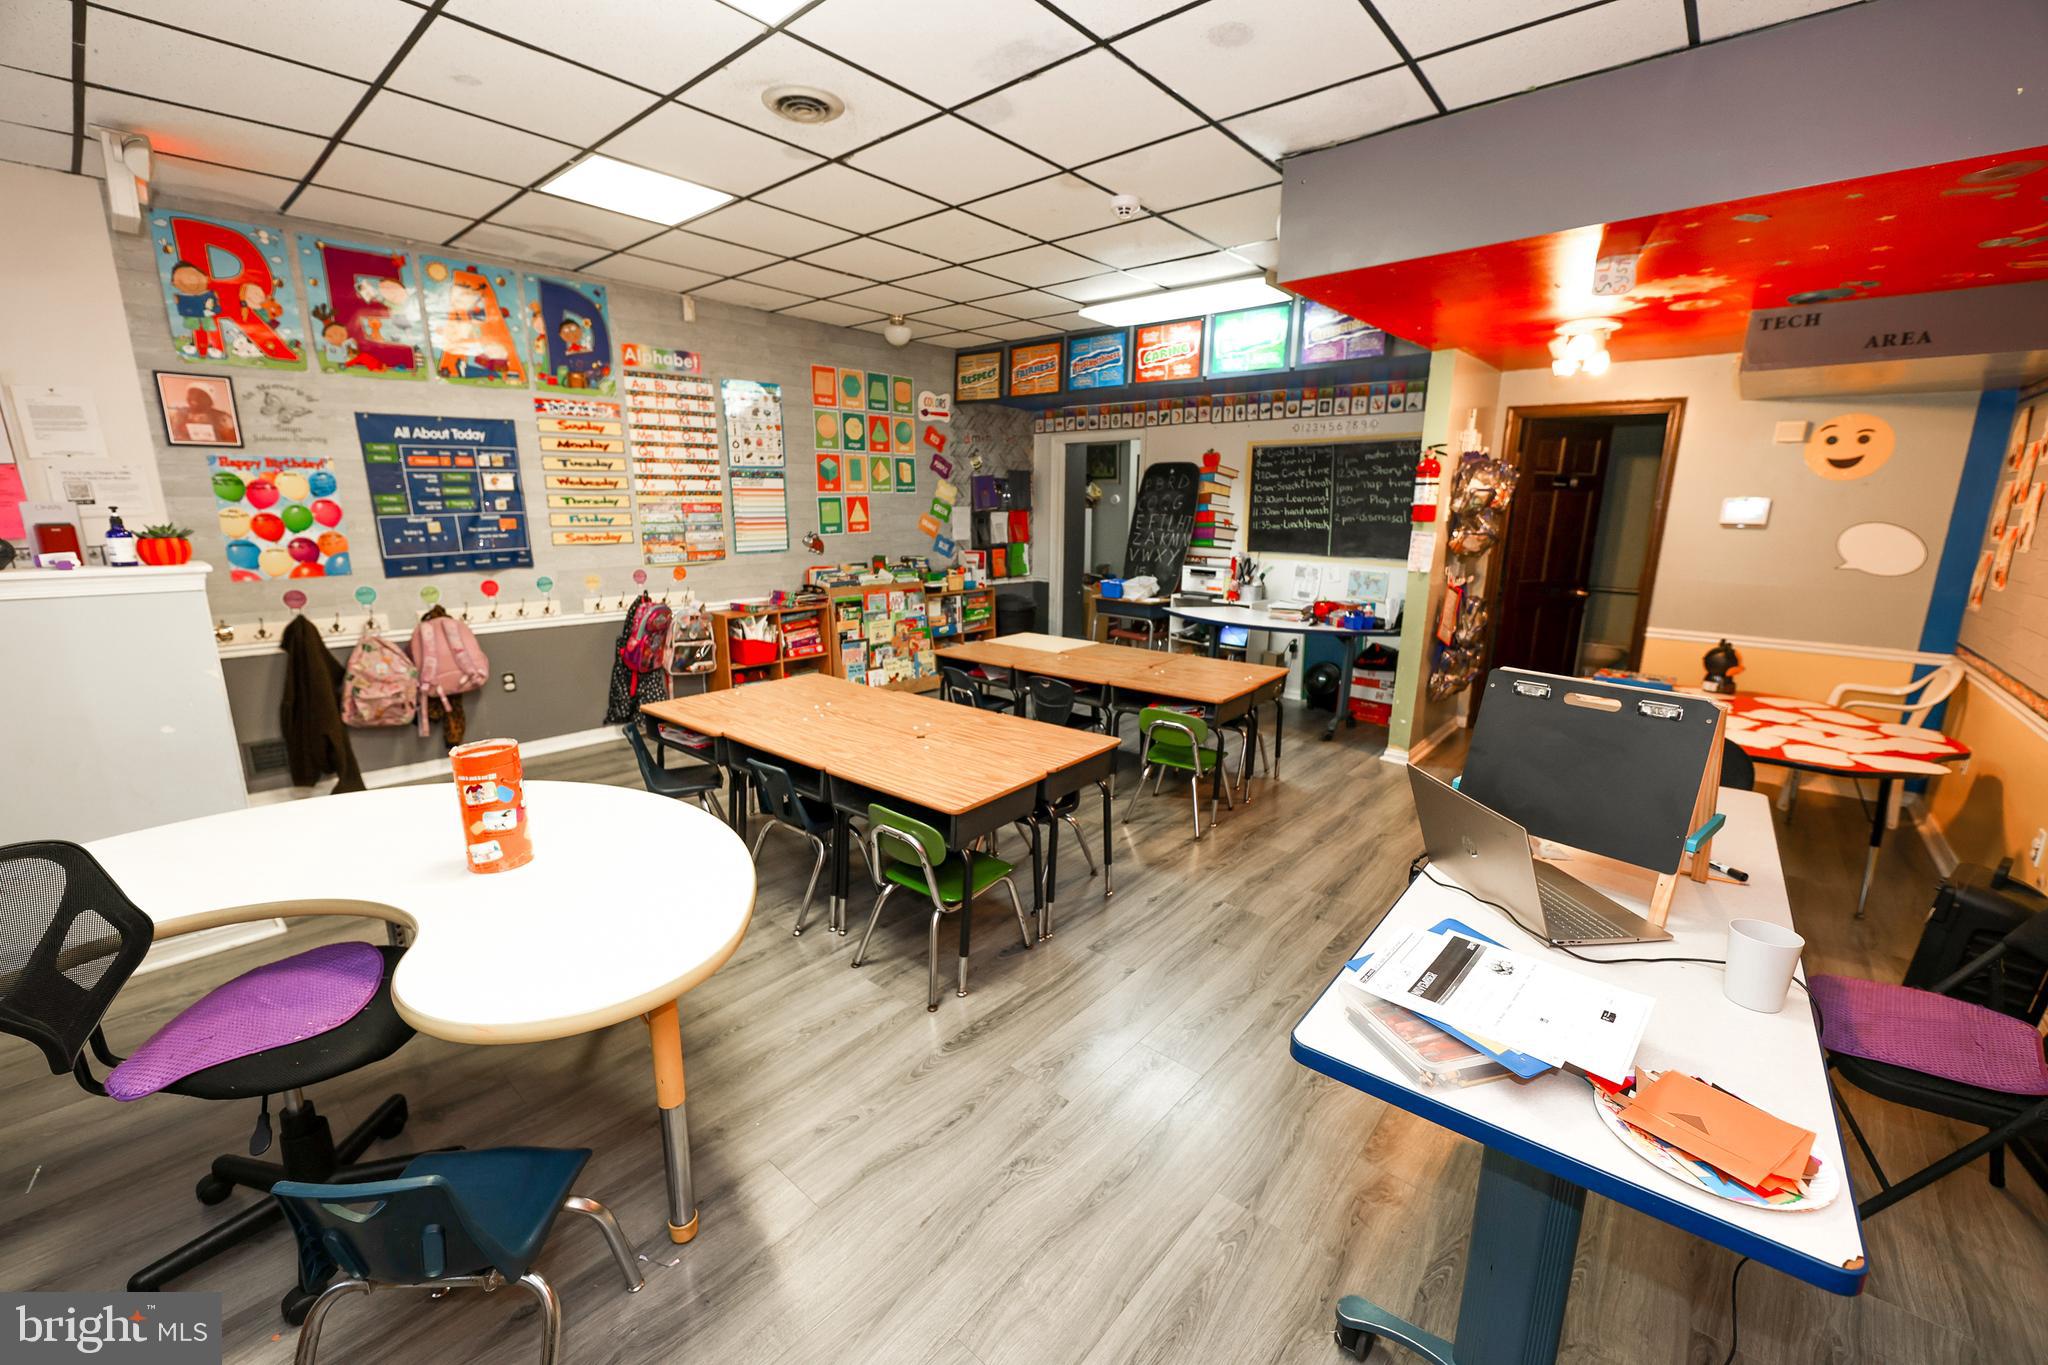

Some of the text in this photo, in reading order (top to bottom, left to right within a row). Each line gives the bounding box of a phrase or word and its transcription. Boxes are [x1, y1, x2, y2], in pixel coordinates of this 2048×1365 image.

[1760, 312, 1823, 331] TECH
[1864, 331, 1932, 349] AREA
[625, 347, 699, 369] Alphabet
[1144, 343, 1189, 363] CARING
[961, 367, 996, 385] RESPECT
[394, 426, 486, 442] All About Today
[218, 456, 260, 470] Happy
[558, 458, 614, 470] Tuesday
[569, 515, 614, 525] Friday
[565, 533, 622, 544] Saturday
